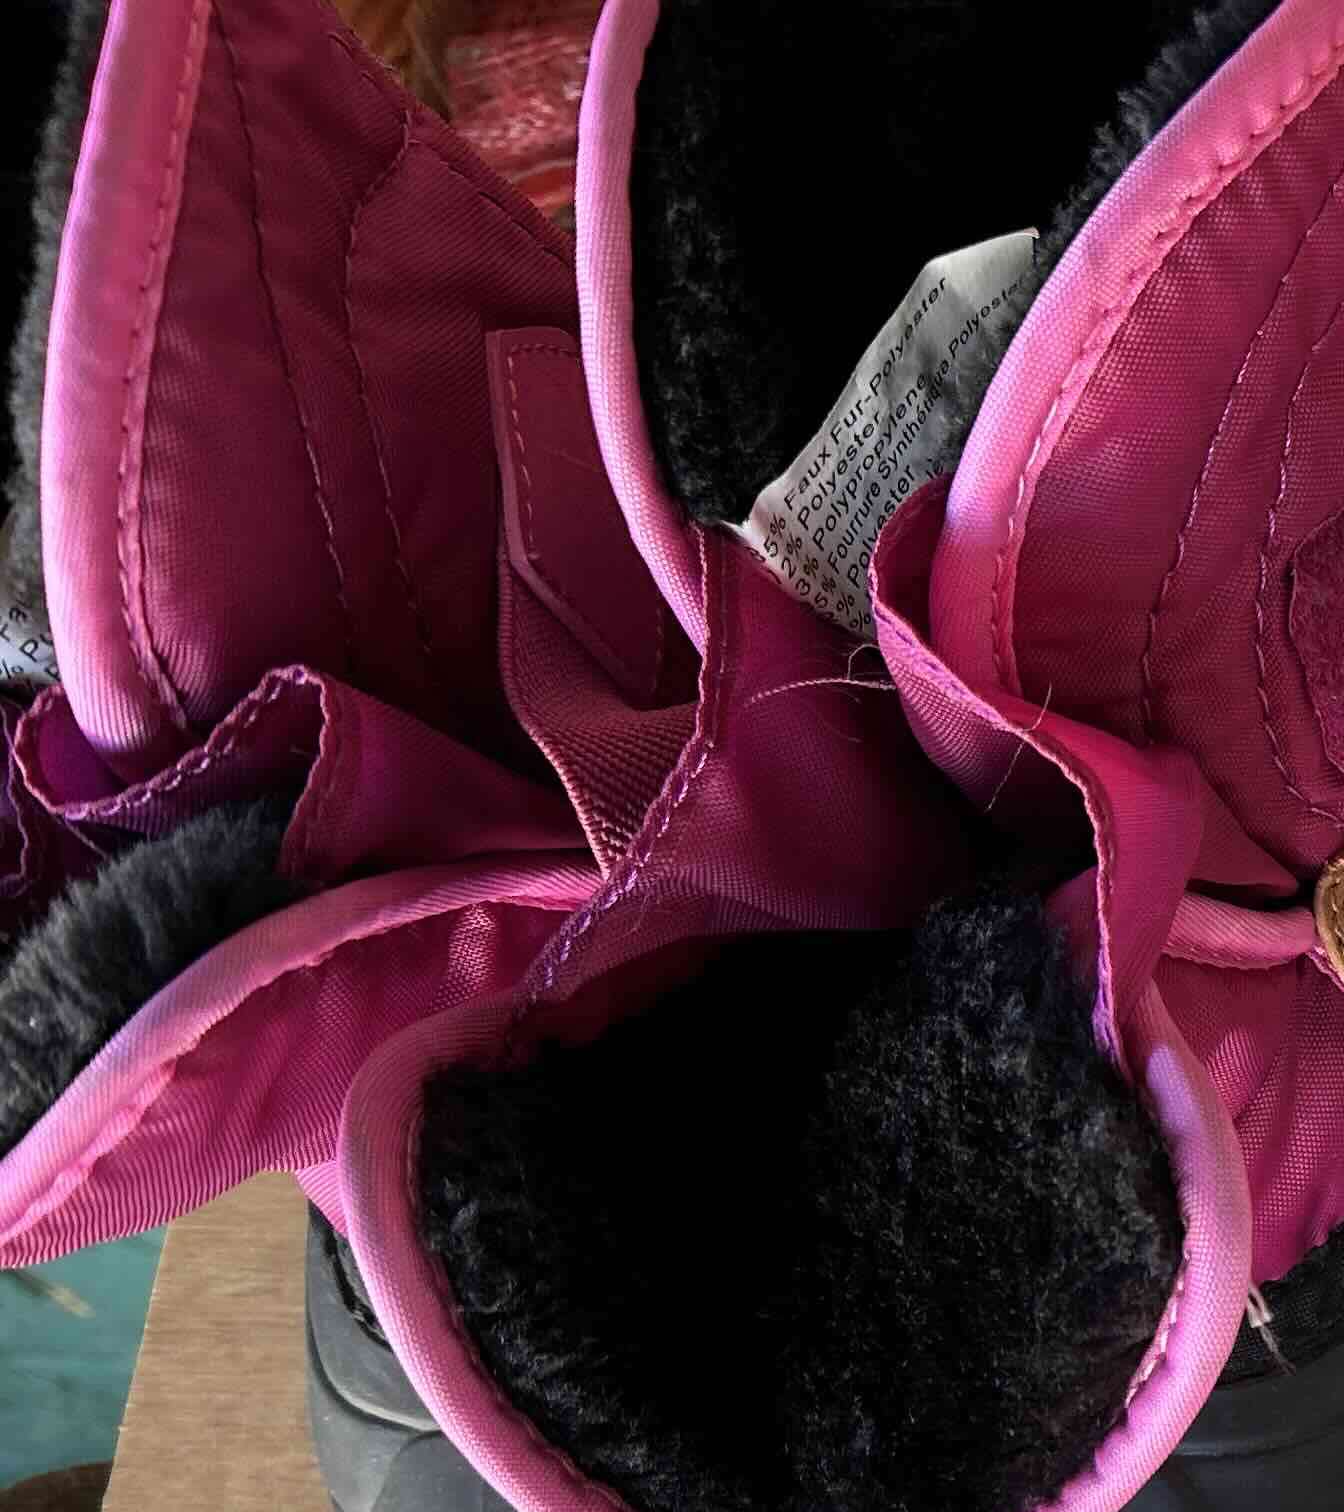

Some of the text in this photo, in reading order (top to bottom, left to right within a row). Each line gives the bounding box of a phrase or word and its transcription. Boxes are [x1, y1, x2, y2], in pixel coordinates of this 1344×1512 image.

[784, 446, 831, 510] Faux
[830, 277, 947, 445] Fur-Polyester
[797, 411, 881, 531] Polyester
[812, 374, 926, 551] Polypropylene
[827, 482, 881, 574] Fourrure
[948, 273, 1023, 359] Polyester
